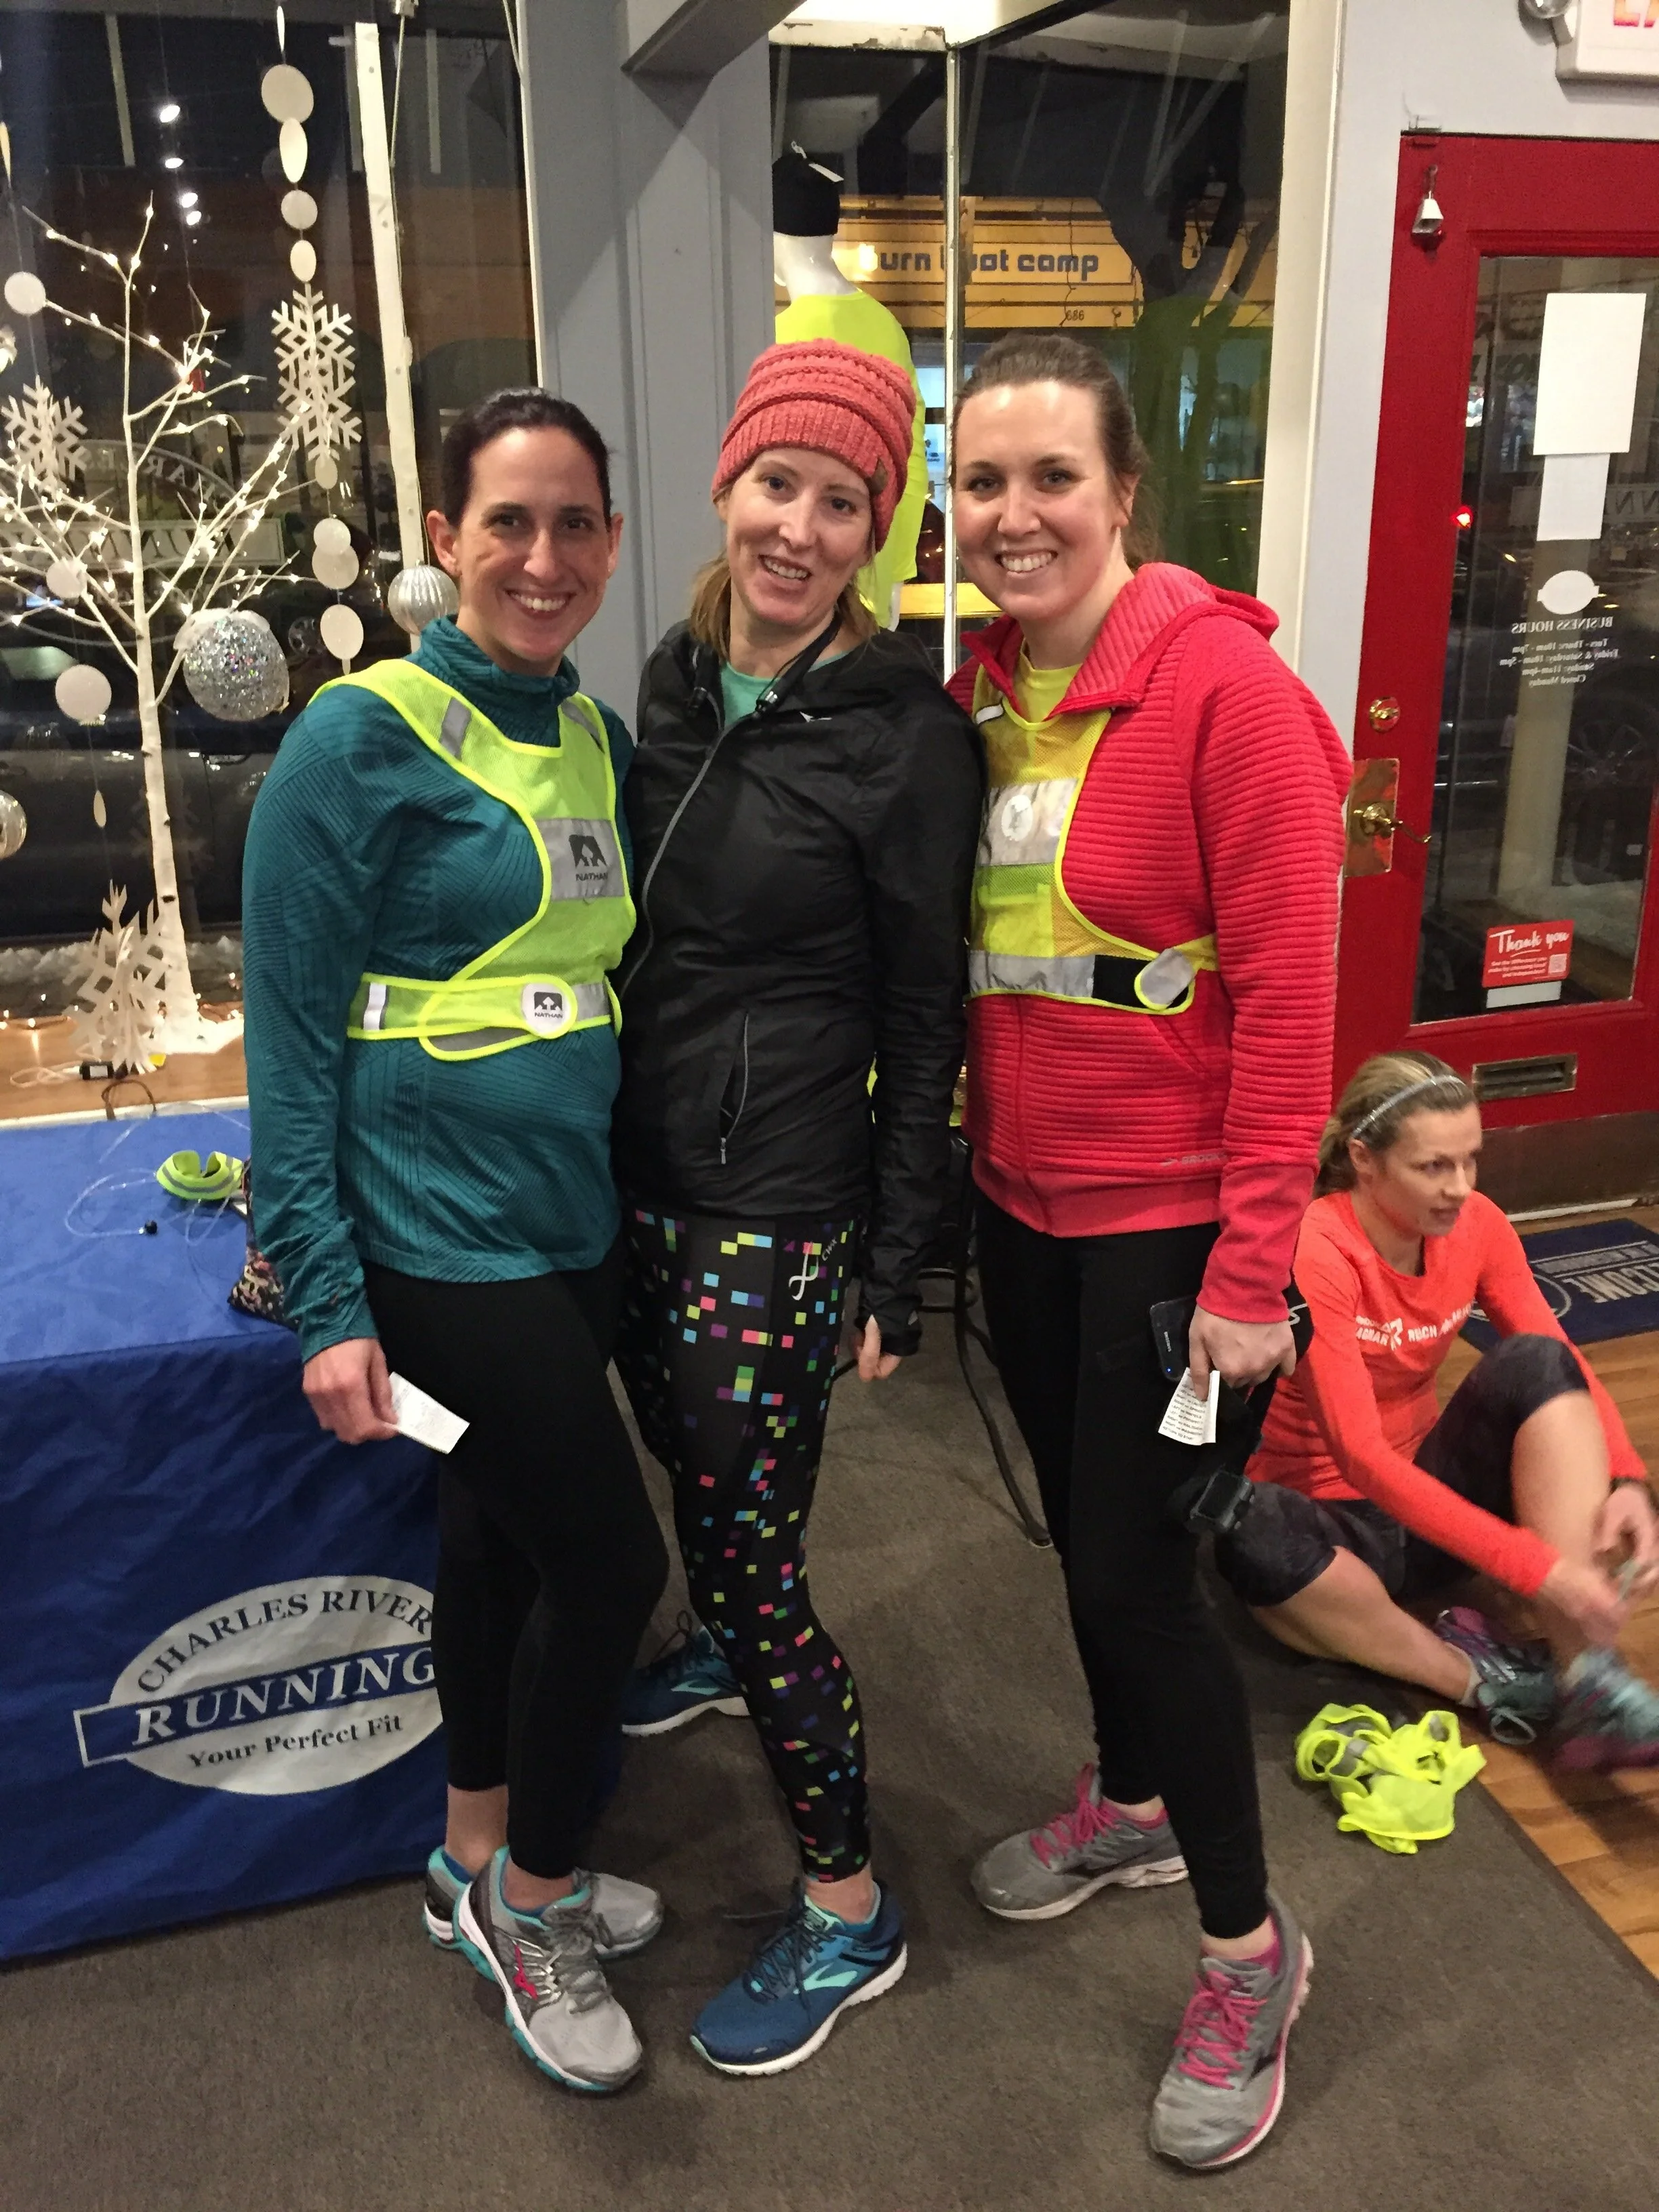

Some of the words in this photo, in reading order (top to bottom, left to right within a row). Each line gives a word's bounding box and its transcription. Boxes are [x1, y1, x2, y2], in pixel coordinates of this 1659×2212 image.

[1017, 254, 1099, 281] camp
[575, 872, 609, 881] NATHAN
[1489, 929, 1543, 954] Thank
[1546, 932, 1570, 949] you
[138, 1593, 308, 1693] CHARLES
[322, 1589, 433, 1635] RIVER
[131, 1645, 434, 1746] RUNNING
[188, 1743, 256, 1767] Your
[266, 1726, 359, 1753] Perfect
[367, 1714, 405, 1737] Fit
